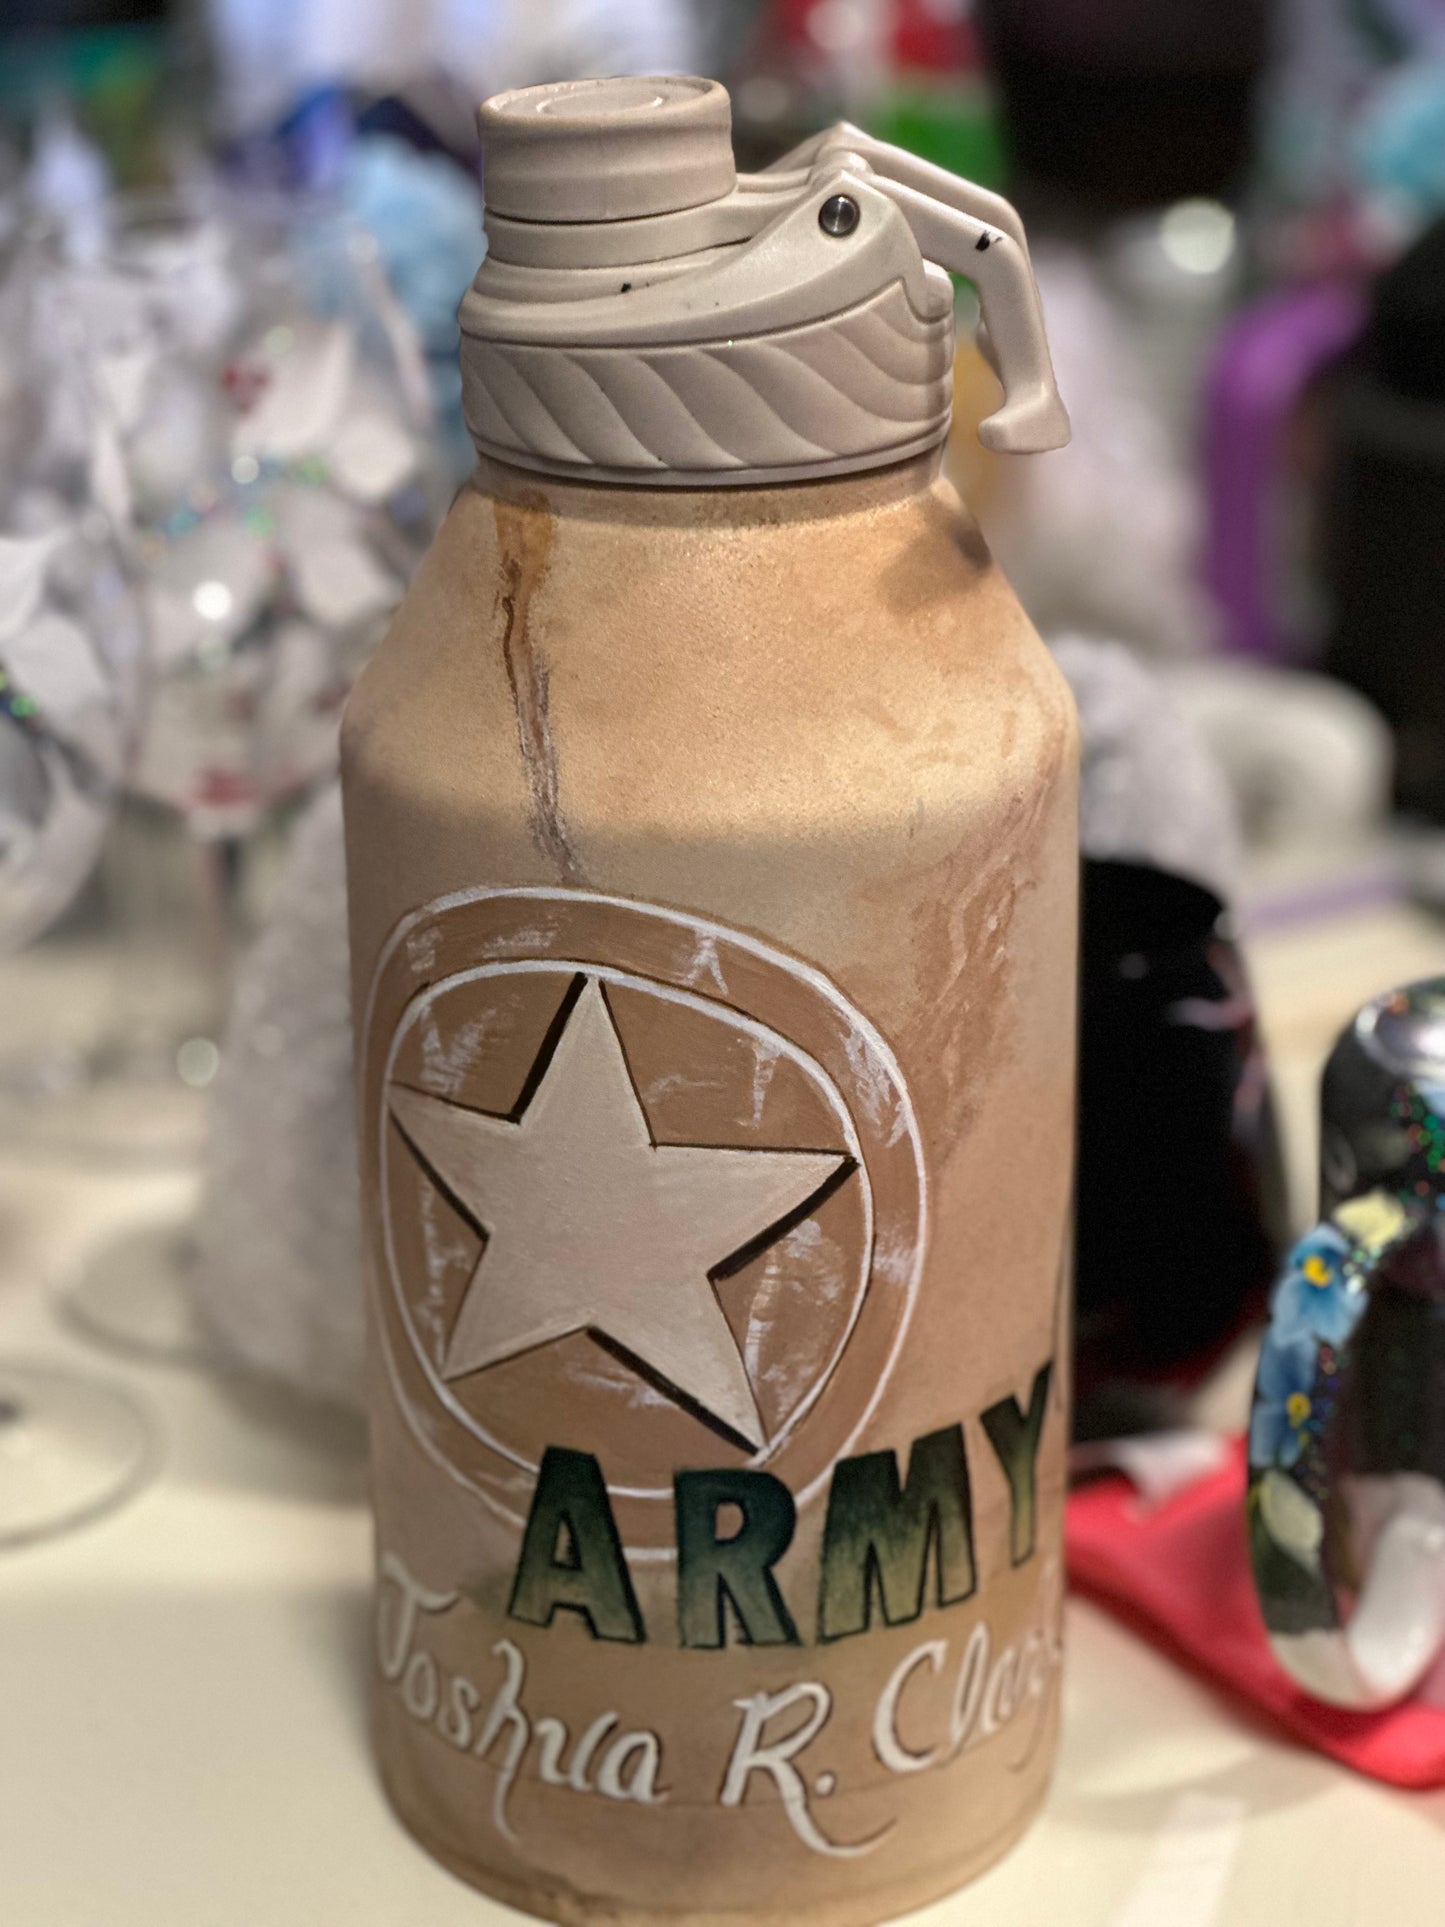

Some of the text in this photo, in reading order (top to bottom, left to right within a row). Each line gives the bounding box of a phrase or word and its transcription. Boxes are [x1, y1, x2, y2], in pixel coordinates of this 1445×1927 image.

[507, 1360, 1053, 1649] ARMY
[377, 1553, 673, 1846] Joshua
[718, 1682, 898, 1859] R.
